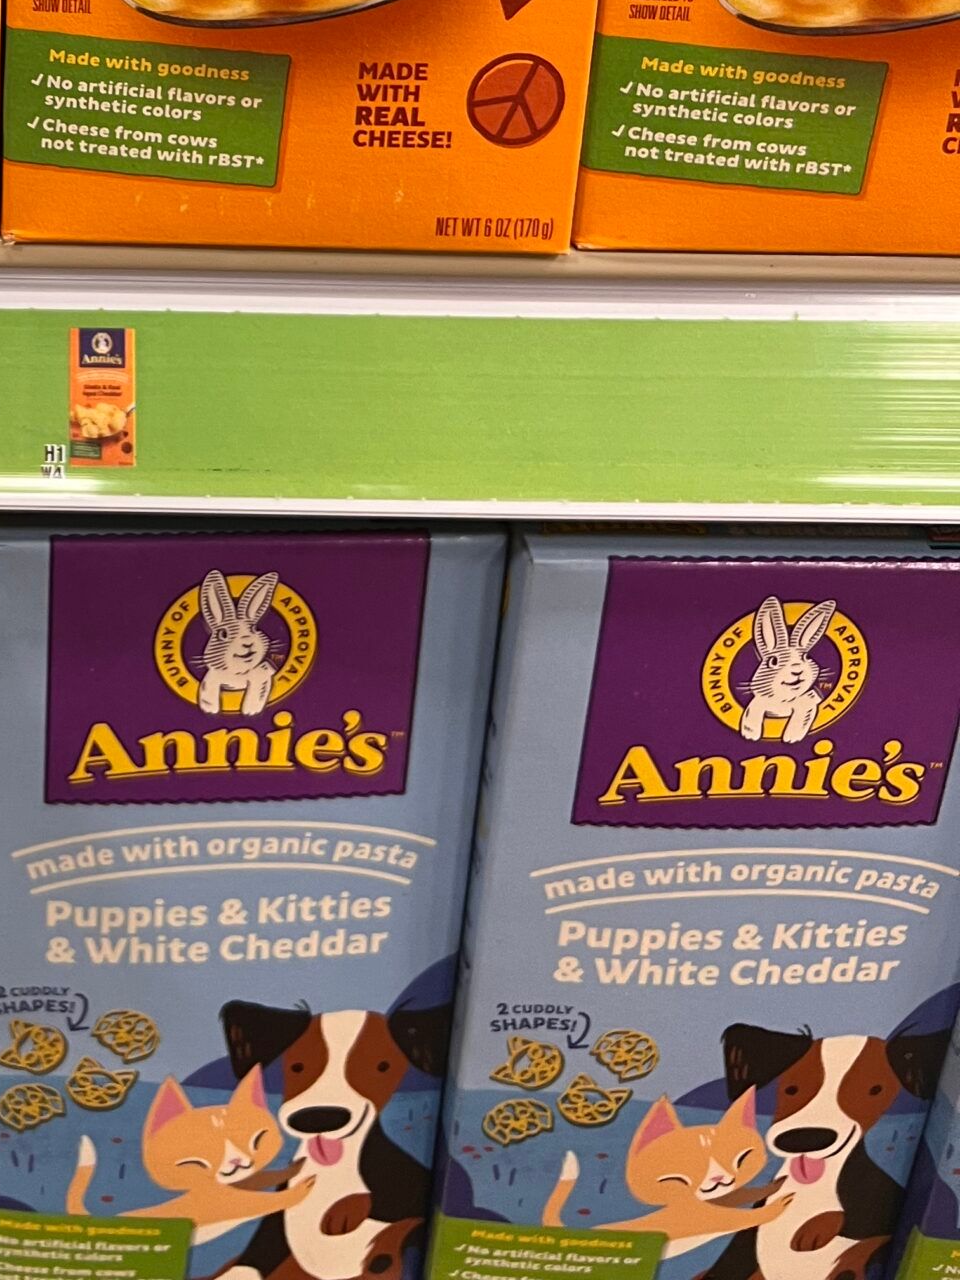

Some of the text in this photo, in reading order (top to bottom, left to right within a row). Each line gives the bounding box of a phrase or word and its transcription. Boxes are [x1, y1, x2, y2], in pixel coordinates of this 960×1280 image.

[48, 48, 250, 83] Made with goodness
[358, 61, 429, 81] MADE
[47, 75, 263, 109] No artificial flavors or
[357, 84, 421, 103] WITH
[45, 94, 202, 121] synthetic colors
[355, 106, 426, 126] REAL
[43, 118, 218, 148] Cheese from cows
[353, 129, 452, 149] CHEESE!
[41, 136, 75, 153] not
[79, 138, 154, 160] treated
[157, 144, 203, 164] with
[435, 217, 458, 236] NET
[461, 218, 481, 237] WT
[484, 218, 492, 237] 6
[495, 218, 511, 238] OZ
[162, 595, 312, 688] BUNNY OF APPROVAL
[68, 710, 387, 784] Annie's
[598, 739, 926, 805] Annie's
[26, 832, 419, 879] made with organic pasta
[544, 861, 940, 900] made with organic pasta
[45, 893, 392, 934] Puppies & Kitties
[45, 929, 390, 965] & White Cheddar
[558, 919, 908, 955] Puppies & Kitties
[552, 956, 901, 986] & White Cheddar
[497, 1002, 574, 1016] 2 CUDDLY
[489, 1017, 579, 1033] SHAPES!
